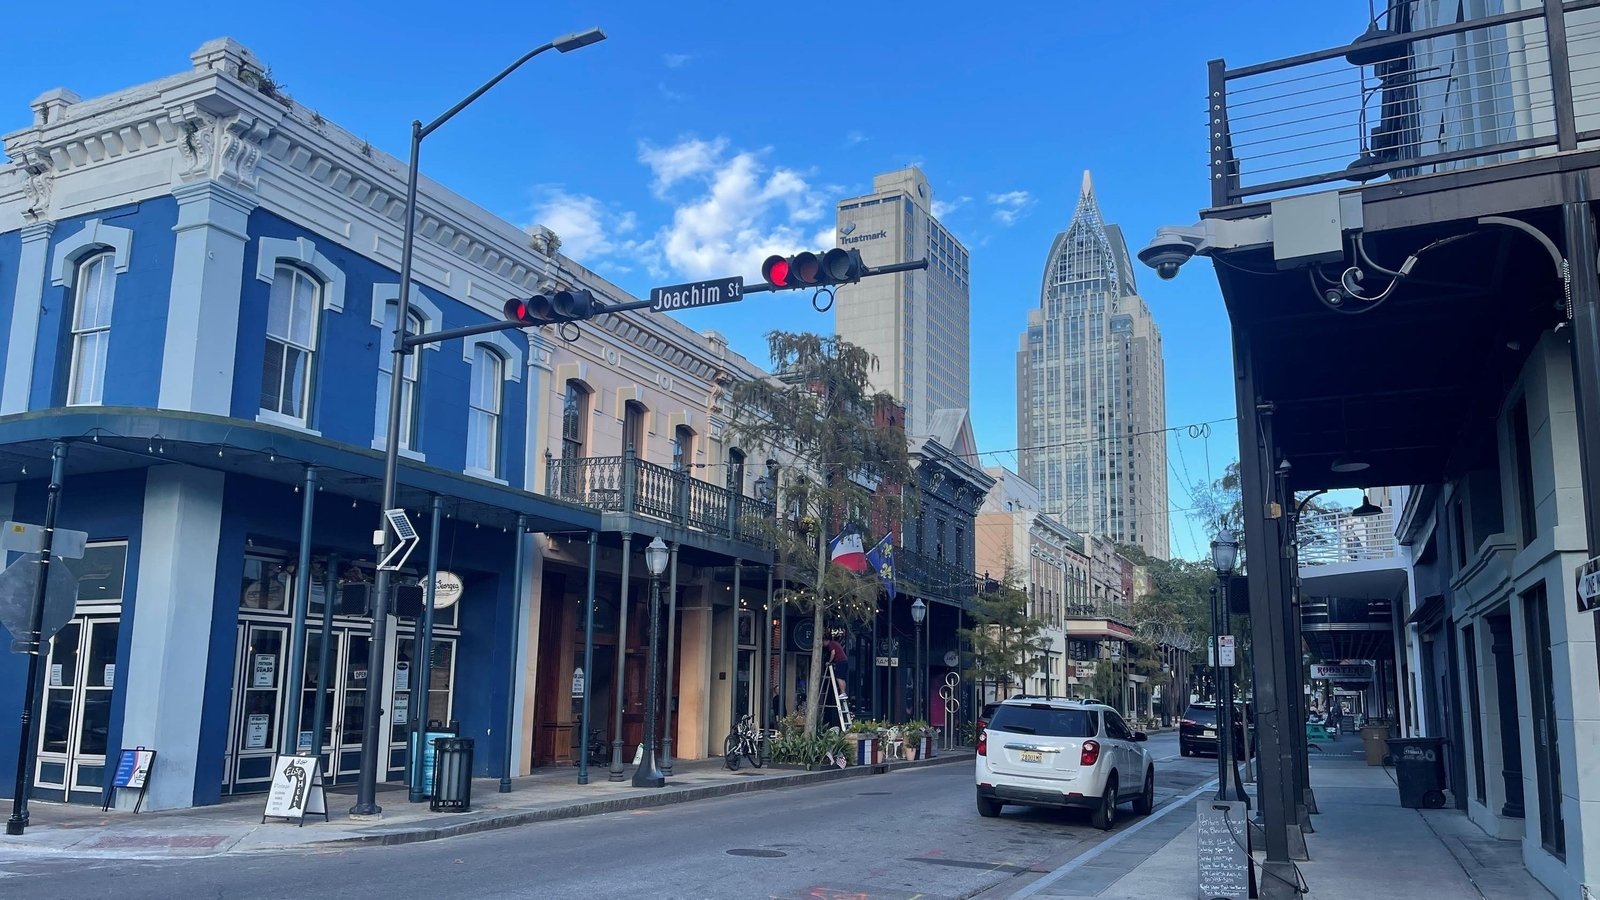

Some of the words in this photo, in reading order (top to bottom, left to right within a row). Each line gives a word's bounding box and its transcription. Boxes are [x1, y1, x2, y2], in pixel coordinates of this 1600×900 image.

[840, 230, 886, 244] Trustmark
[654, 284, 720, 310] Joachim
[728, 282, 740, 297] St
[1586, 576, 1596, 596] ONE
